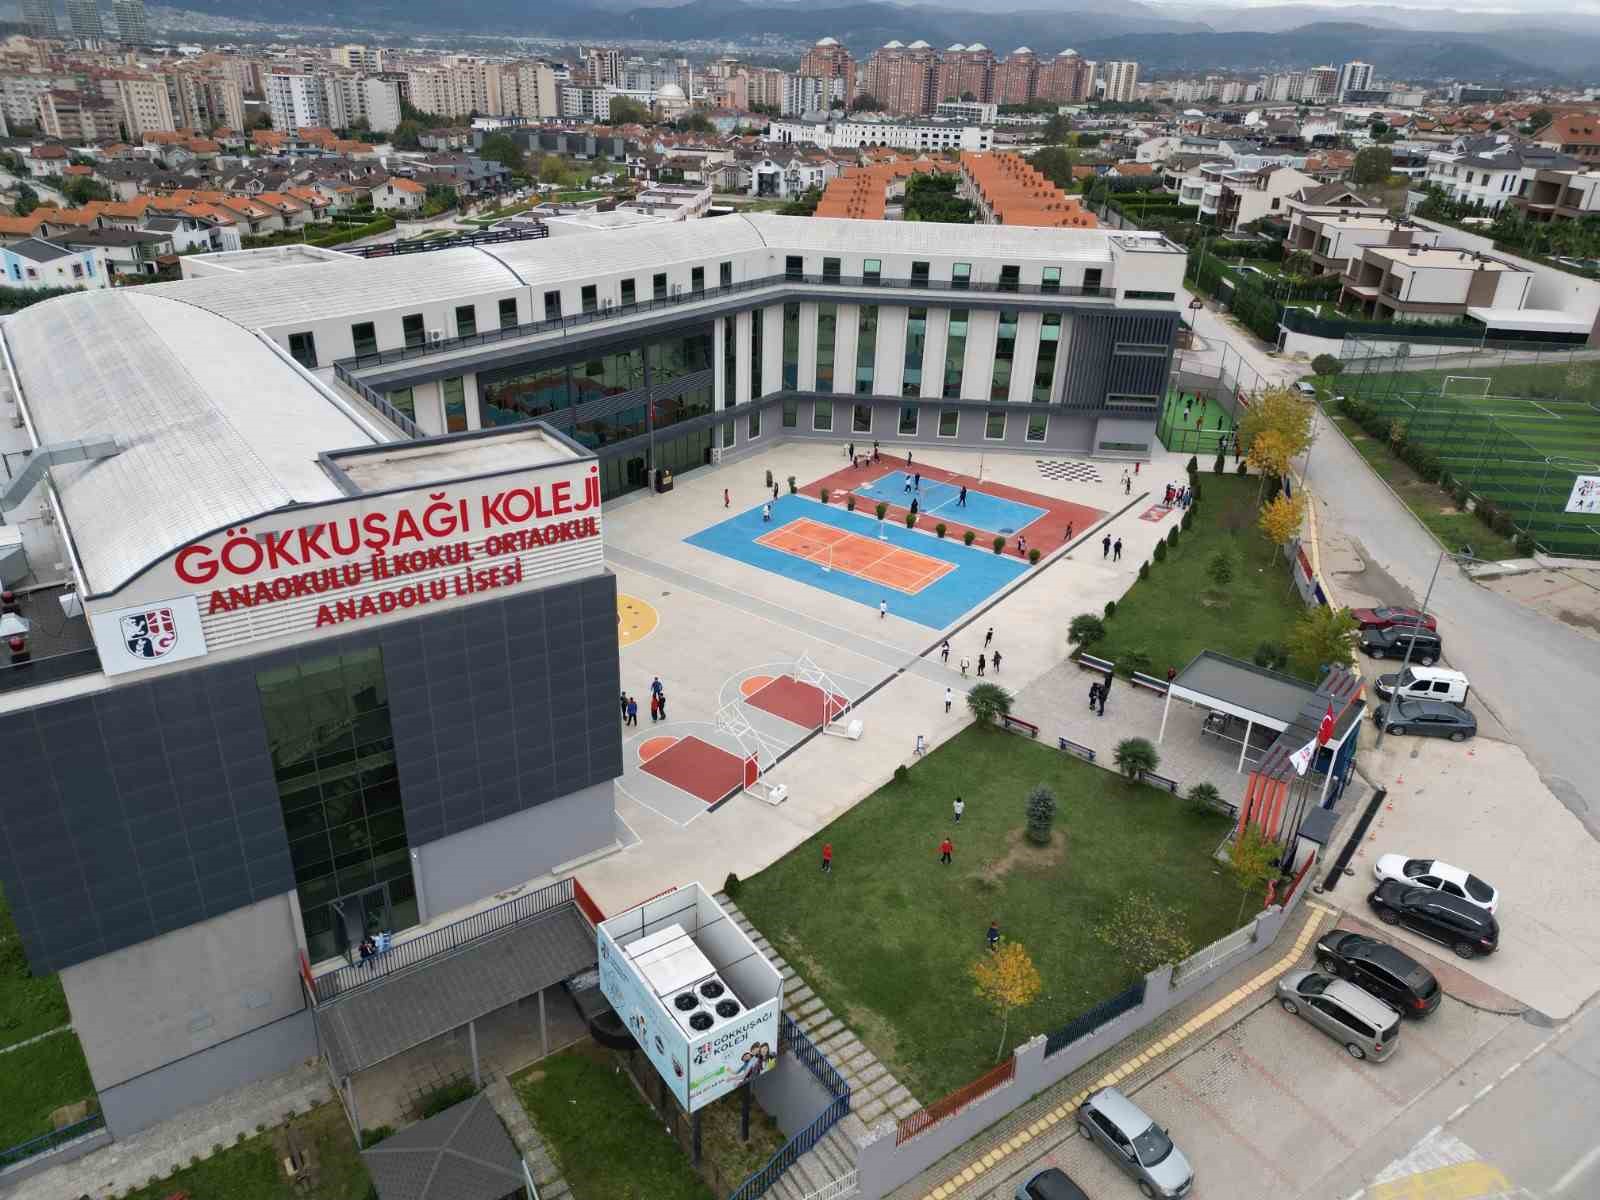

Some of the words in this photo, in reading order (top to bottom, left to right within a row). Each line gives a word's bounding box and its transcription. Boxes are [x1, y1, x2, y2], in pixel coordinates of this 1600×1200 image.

[174, 491, 470, 586] GÖKKUŞAĞI
[481, 465, 600, 530] KOLEJİ
[315, 579, 449, 628] ANADOLU
[453, 557, 523, 597] LİSESİ
